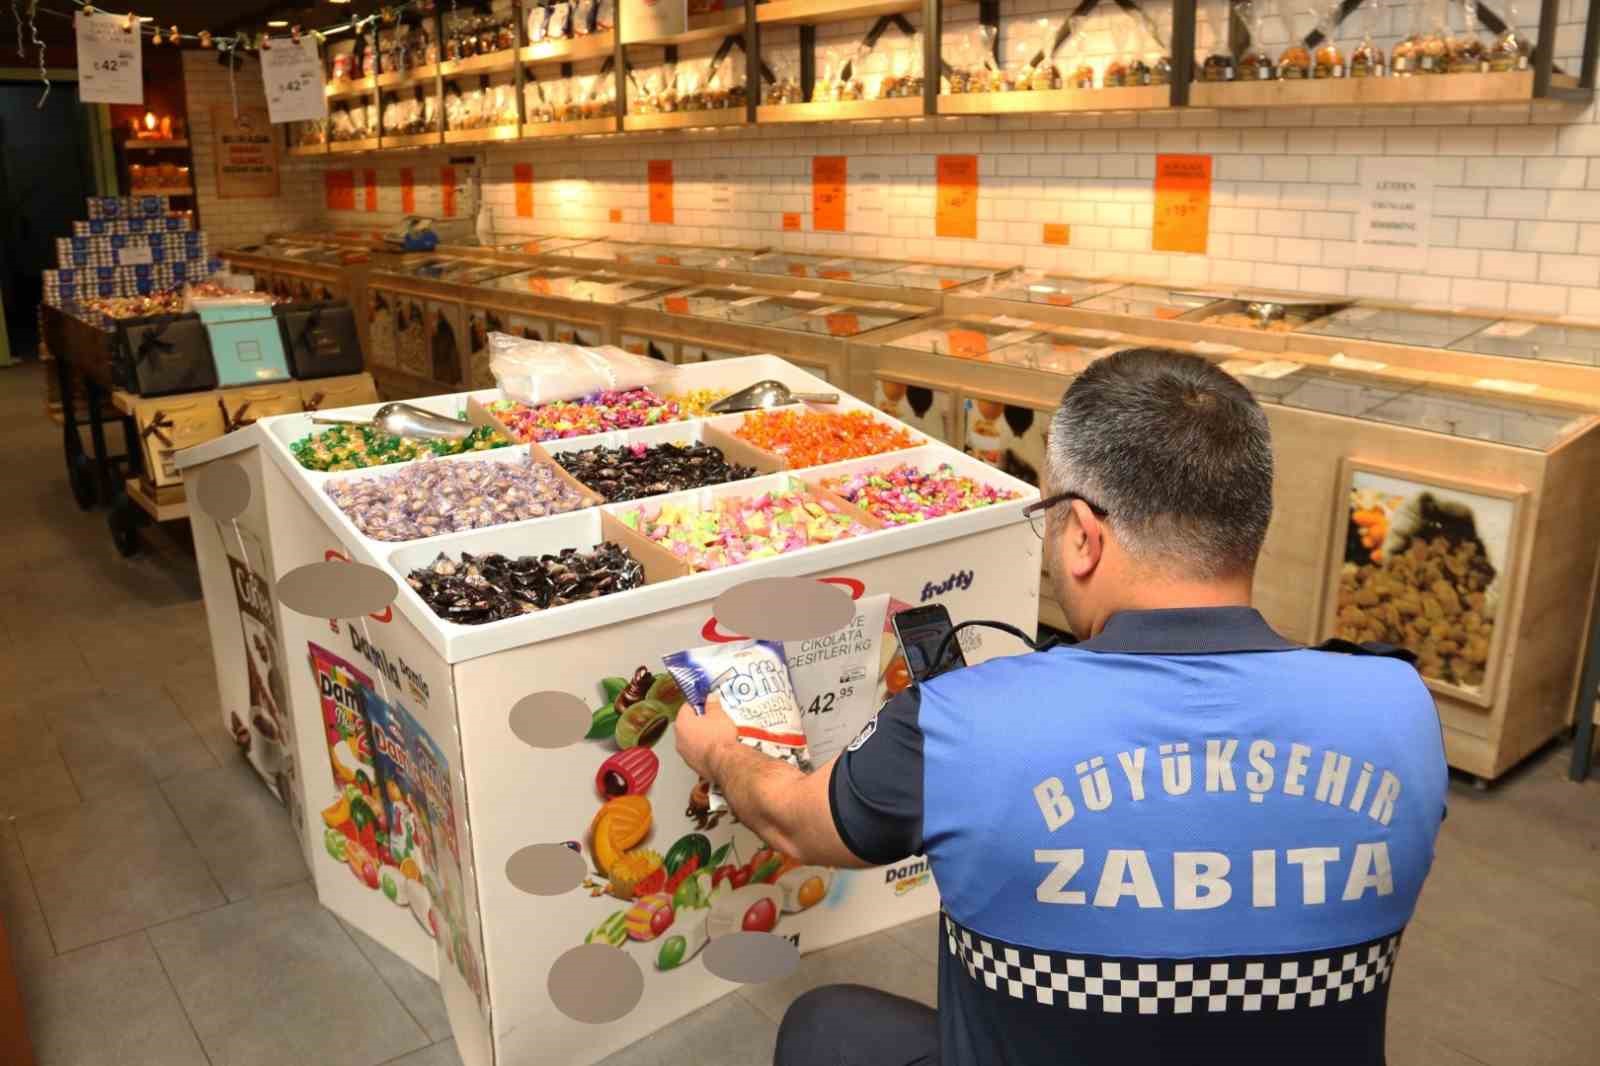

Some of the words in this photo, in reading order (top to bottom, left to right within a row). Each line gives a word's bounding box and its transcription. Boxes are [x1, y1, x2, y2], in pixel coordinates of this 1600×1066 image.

[920, 569, 974, 602] frutty
[807, 691, 835, 715] 42
[1033, 739, 1401, 833] BÜYÜKŞEHİR
[1034, 841, 1394, 911] ZABITA
